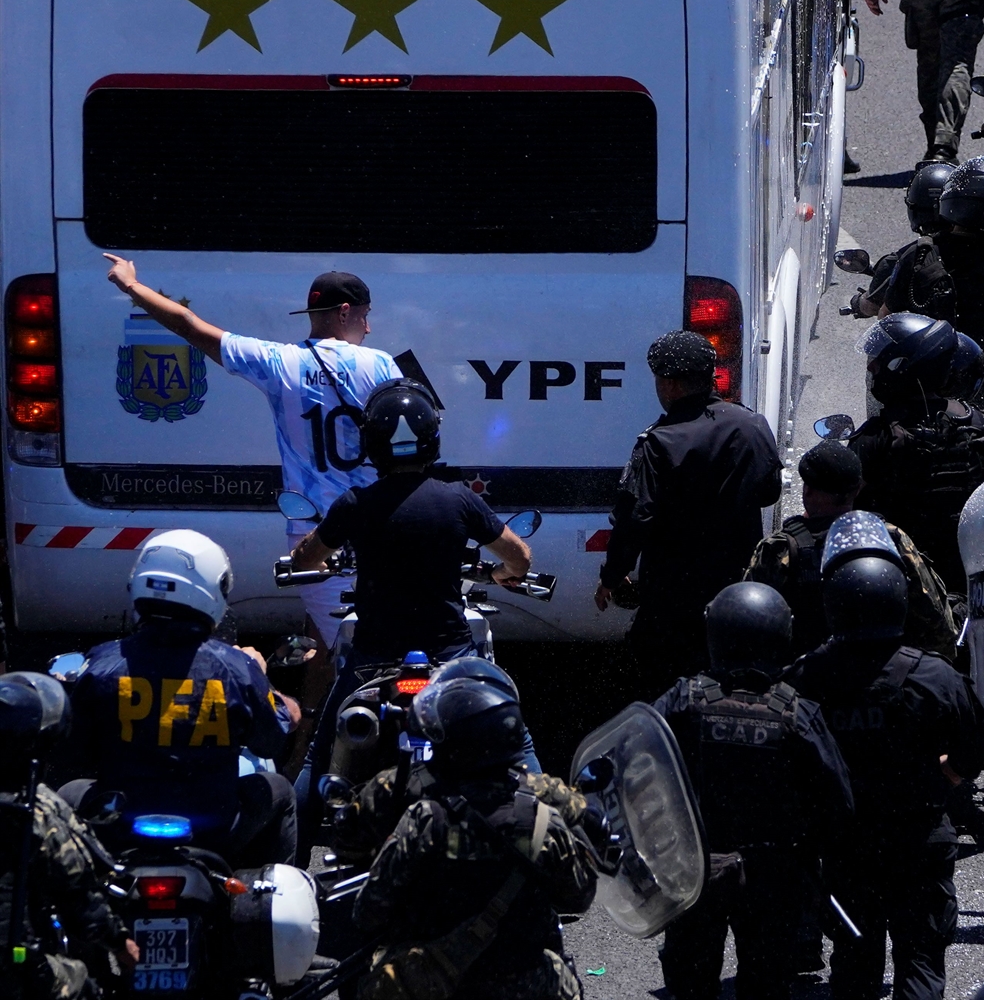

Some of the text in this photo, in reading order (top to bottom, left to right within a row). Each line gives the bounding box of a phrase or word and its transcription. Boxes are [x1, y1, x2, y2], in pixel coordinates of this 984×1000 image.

[136, 350, 188, 399] AFA
[466, 359, 626, 401] YPF
[300, 404, 367, 473] 10
[101, 472, 265, 496] Mercedes-Benz
[118, 676, 231, 747] PFA
[146, 930, 177, 947] 397
[134, 970, 187, 991] 3769
